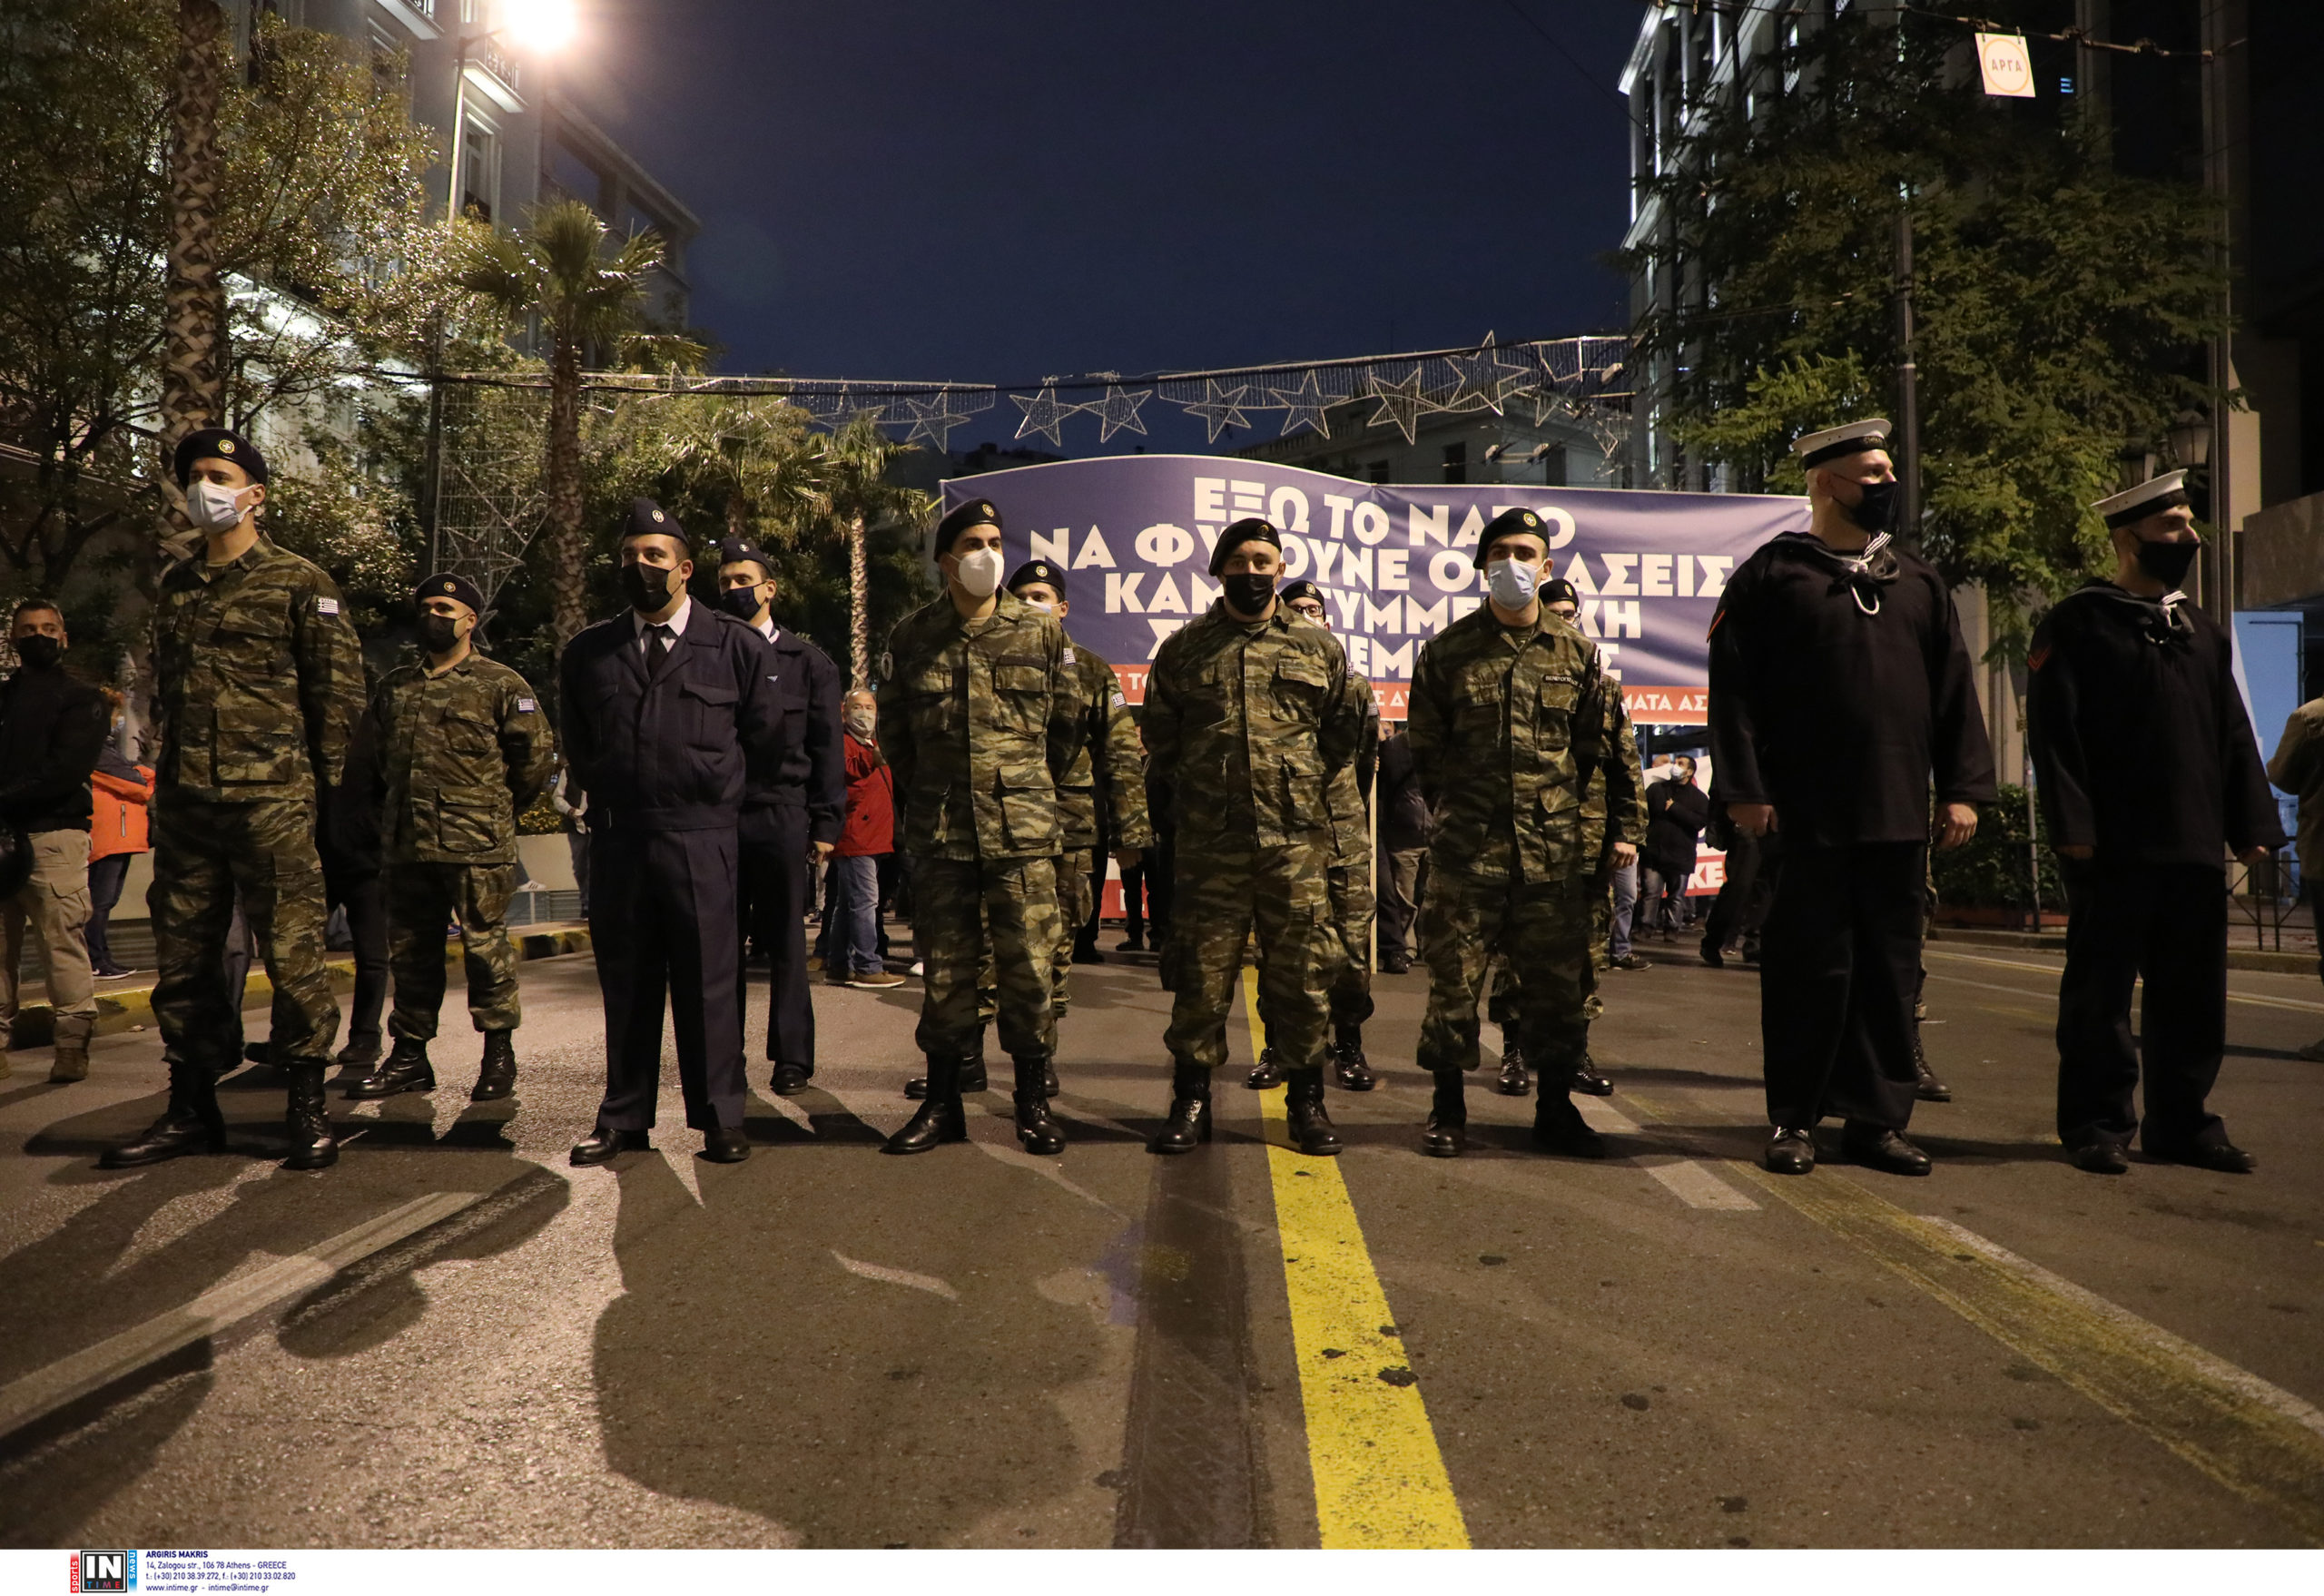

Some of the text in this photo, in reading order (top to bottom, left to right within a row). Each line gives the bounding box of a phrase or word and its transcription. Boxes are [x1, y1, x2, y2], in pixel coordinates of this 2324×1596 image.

[1992, 58, 2023, 72] ΑΡΓΑ
[1194, 477, 1310, 534] ΕΞΩ
[1324, 494, 1390, 546] ΤΟ
[1030, 524, 1118, 571] ΝΑ
[1541, 551, 1734, 597] ΑΣΕΙΣ
